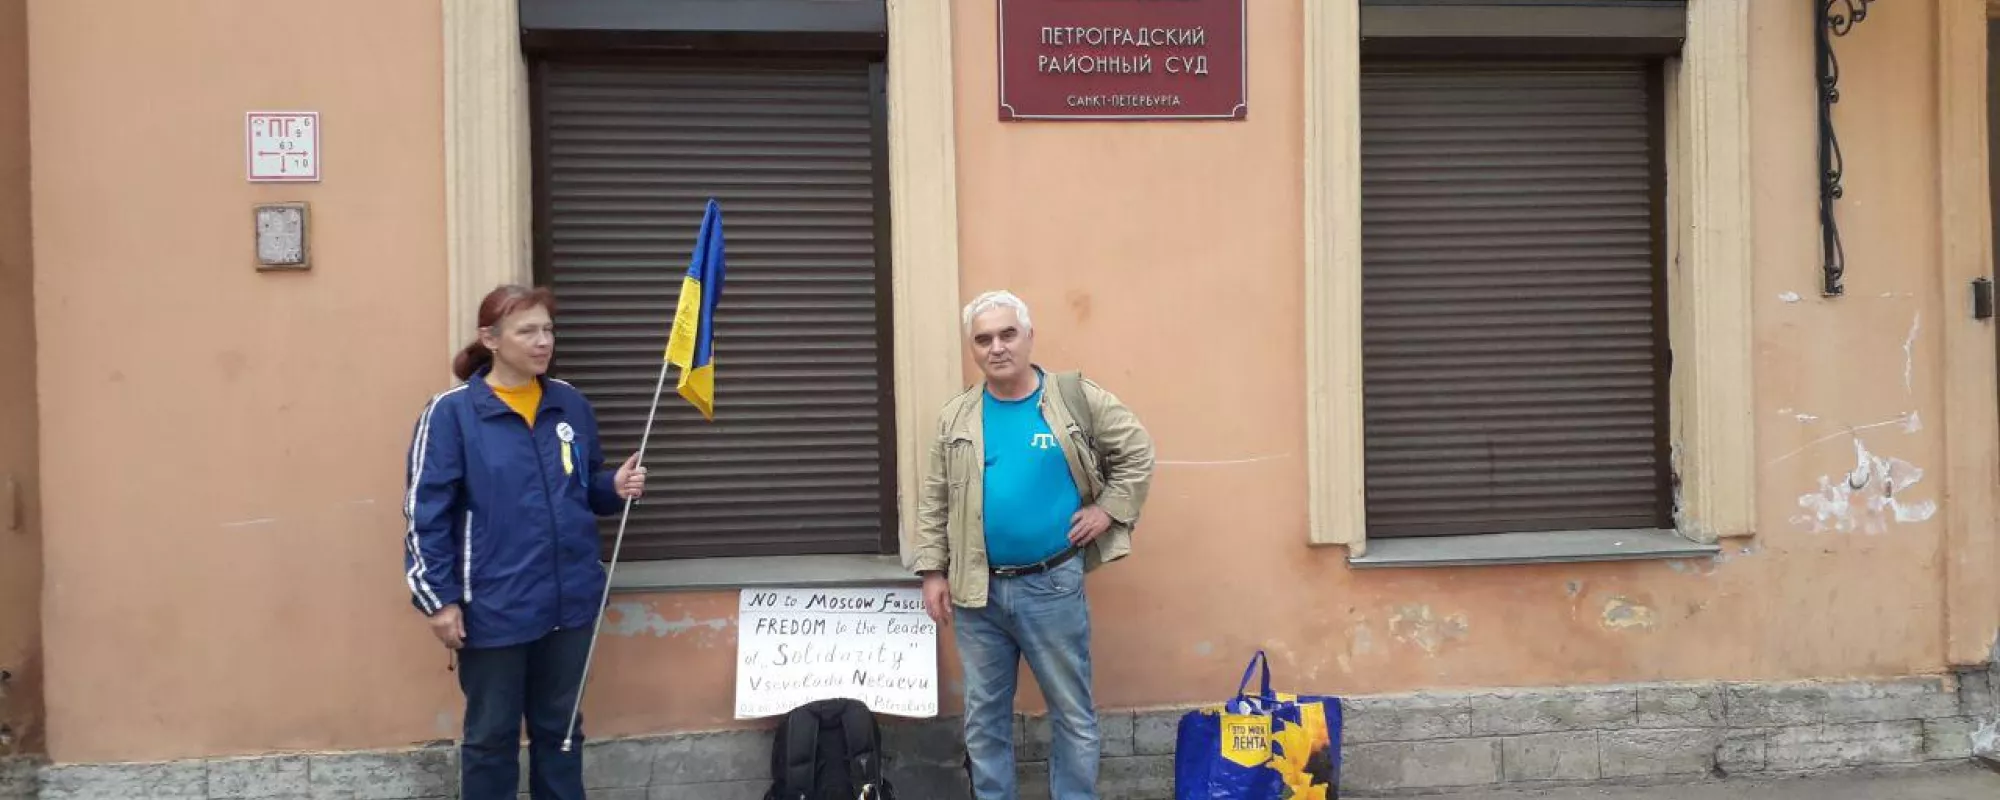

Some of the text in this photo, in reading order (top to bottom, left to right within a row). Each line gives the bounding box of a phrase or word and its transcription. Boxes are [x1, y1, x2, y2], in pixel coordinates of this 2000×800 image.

[1041, 26, 1205, 47] ПЕТРОГРАДСКИЙ
[1038, 54, 1209, 75] РАЙОННЫЙ СУД
[1066, 94, 1181, 107] САНКТ-ПЕТЕРБУРГА
[269, 118, 296, 137] ПГ
[749, 592, 778, 607] NO
[805, 593, 876, 611] Moscow
[755, 617, 826, 635] FREDOM
[855, 617, 877, 635] the
[1233, 736, 1266, 749] ЛЕНТА
